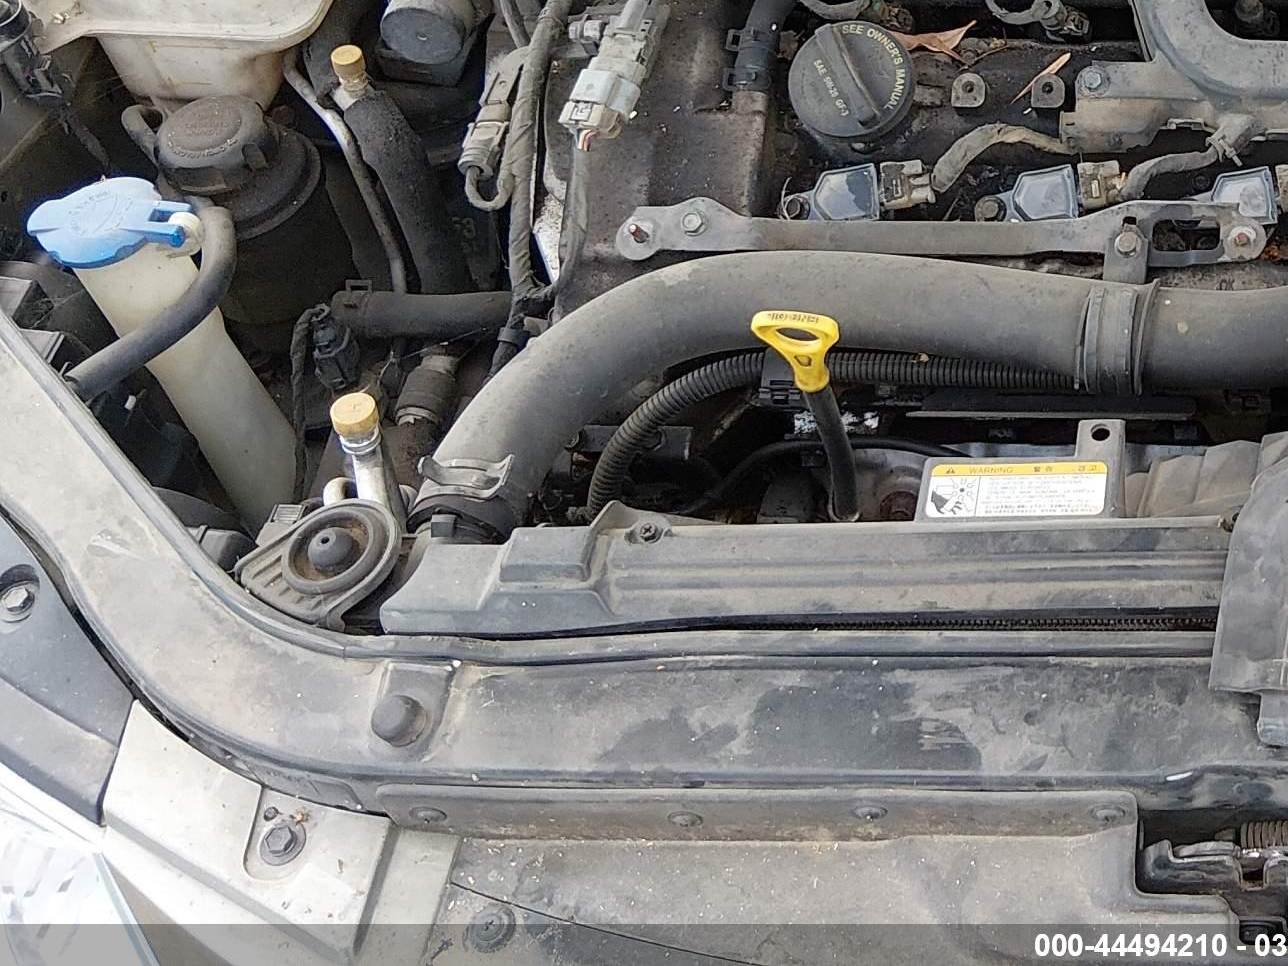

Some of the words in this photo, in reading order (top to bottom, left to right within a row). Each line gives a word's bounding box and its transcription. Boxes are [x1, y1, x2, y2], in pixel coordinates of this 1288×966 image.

[842, 24, 865, 34] SEE
[867, 28, 904, 64] OWNER'S
[813, 59, 828, 75] SAE
[884, 68, 906, 110] MANUAL
[969, 466, 1015, 474] WARNING
